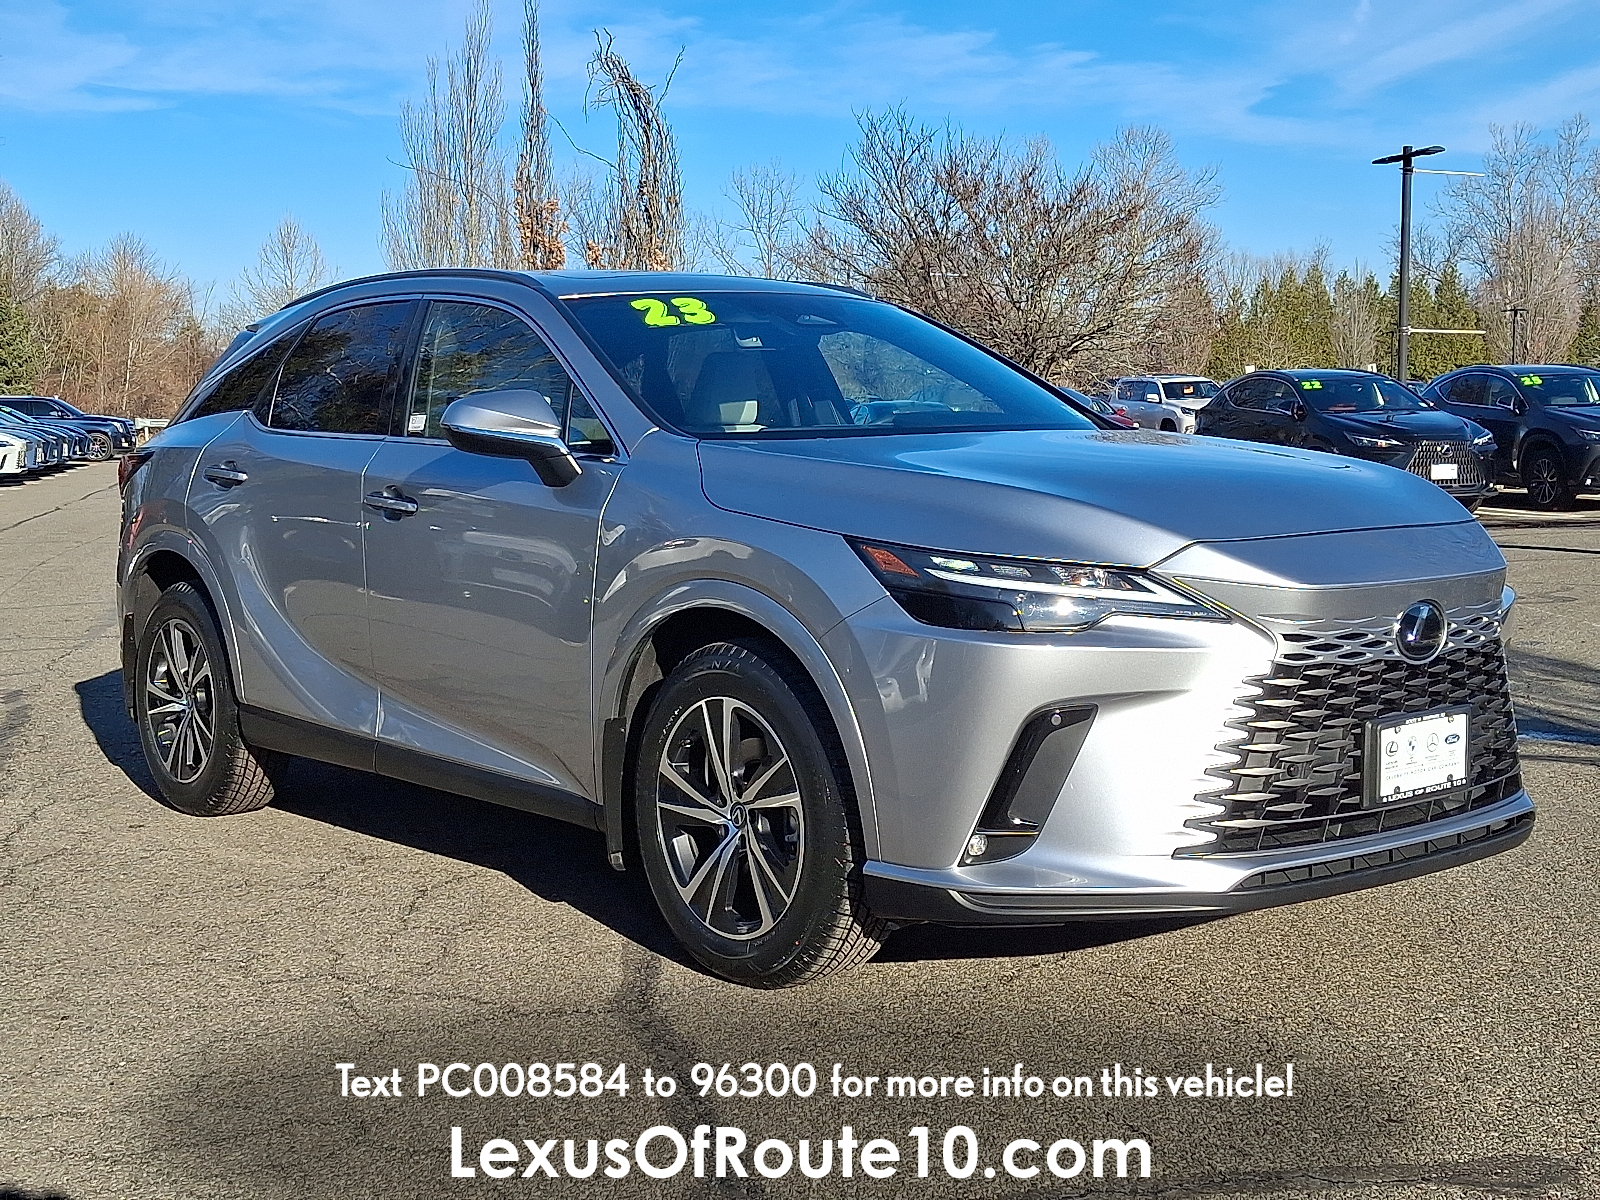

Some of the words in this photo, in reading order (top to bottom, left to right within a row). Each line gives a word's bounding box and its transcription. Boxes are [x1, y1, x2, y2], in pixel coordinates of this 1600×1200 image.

[630, 297, 717, 327] 23
[1300, 381, 1323, 390] 22
[1387, 791, 1413, 802] LEXUS
[1425, 782, 1451, 793] ROUTE
[1452, 780, 1461, 788] 10
